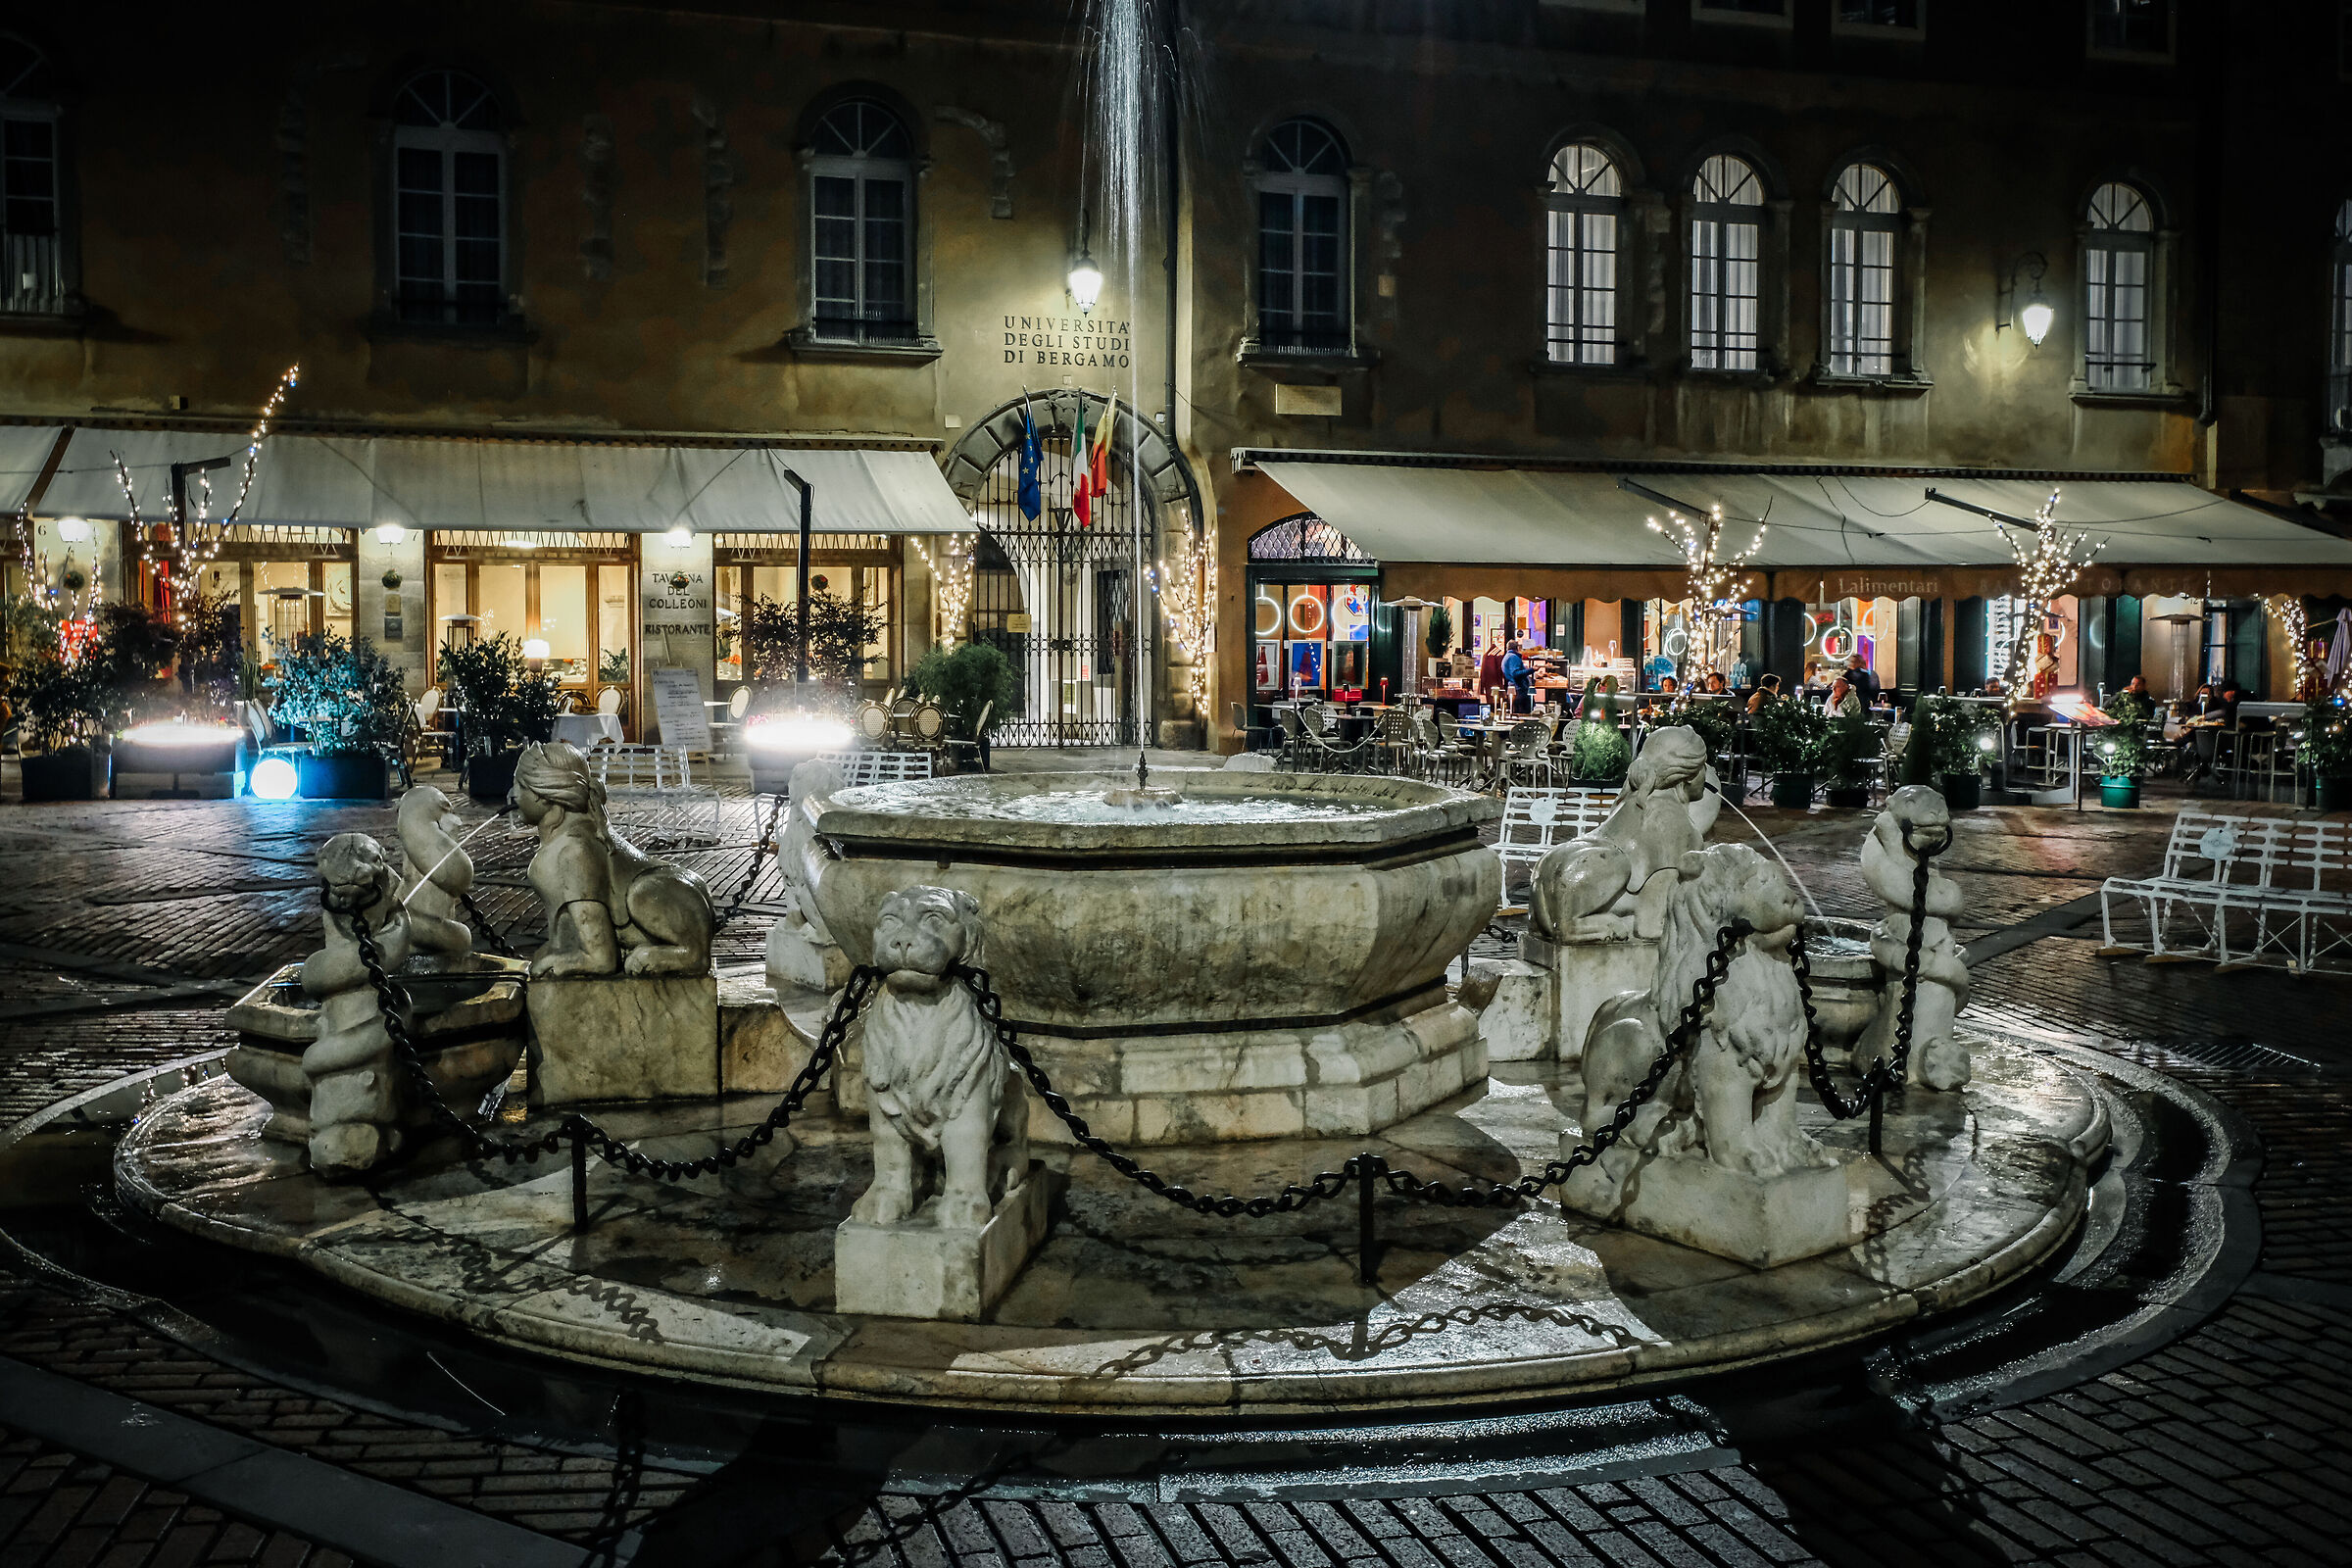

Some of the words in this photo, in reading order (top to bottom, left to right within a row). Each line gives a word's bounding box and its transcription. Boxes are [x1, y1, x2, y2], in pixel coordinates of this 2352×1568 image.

[1004, 332, 1063, 348] DEGLI
[1073, 336, 1130, 351] STUDI
[1004, 349, 1024, 364] DI
[1037, 351, 1130, 368] BERGAMO
[37, 524, 47, 536] 6
[667, 585, 690, 596] DEL
[1838, 576, 1938, 595] Lalimentari
[649, 598, 707, 609] COLLEONI
[645, 624, 710, 635] RISTORANTE
